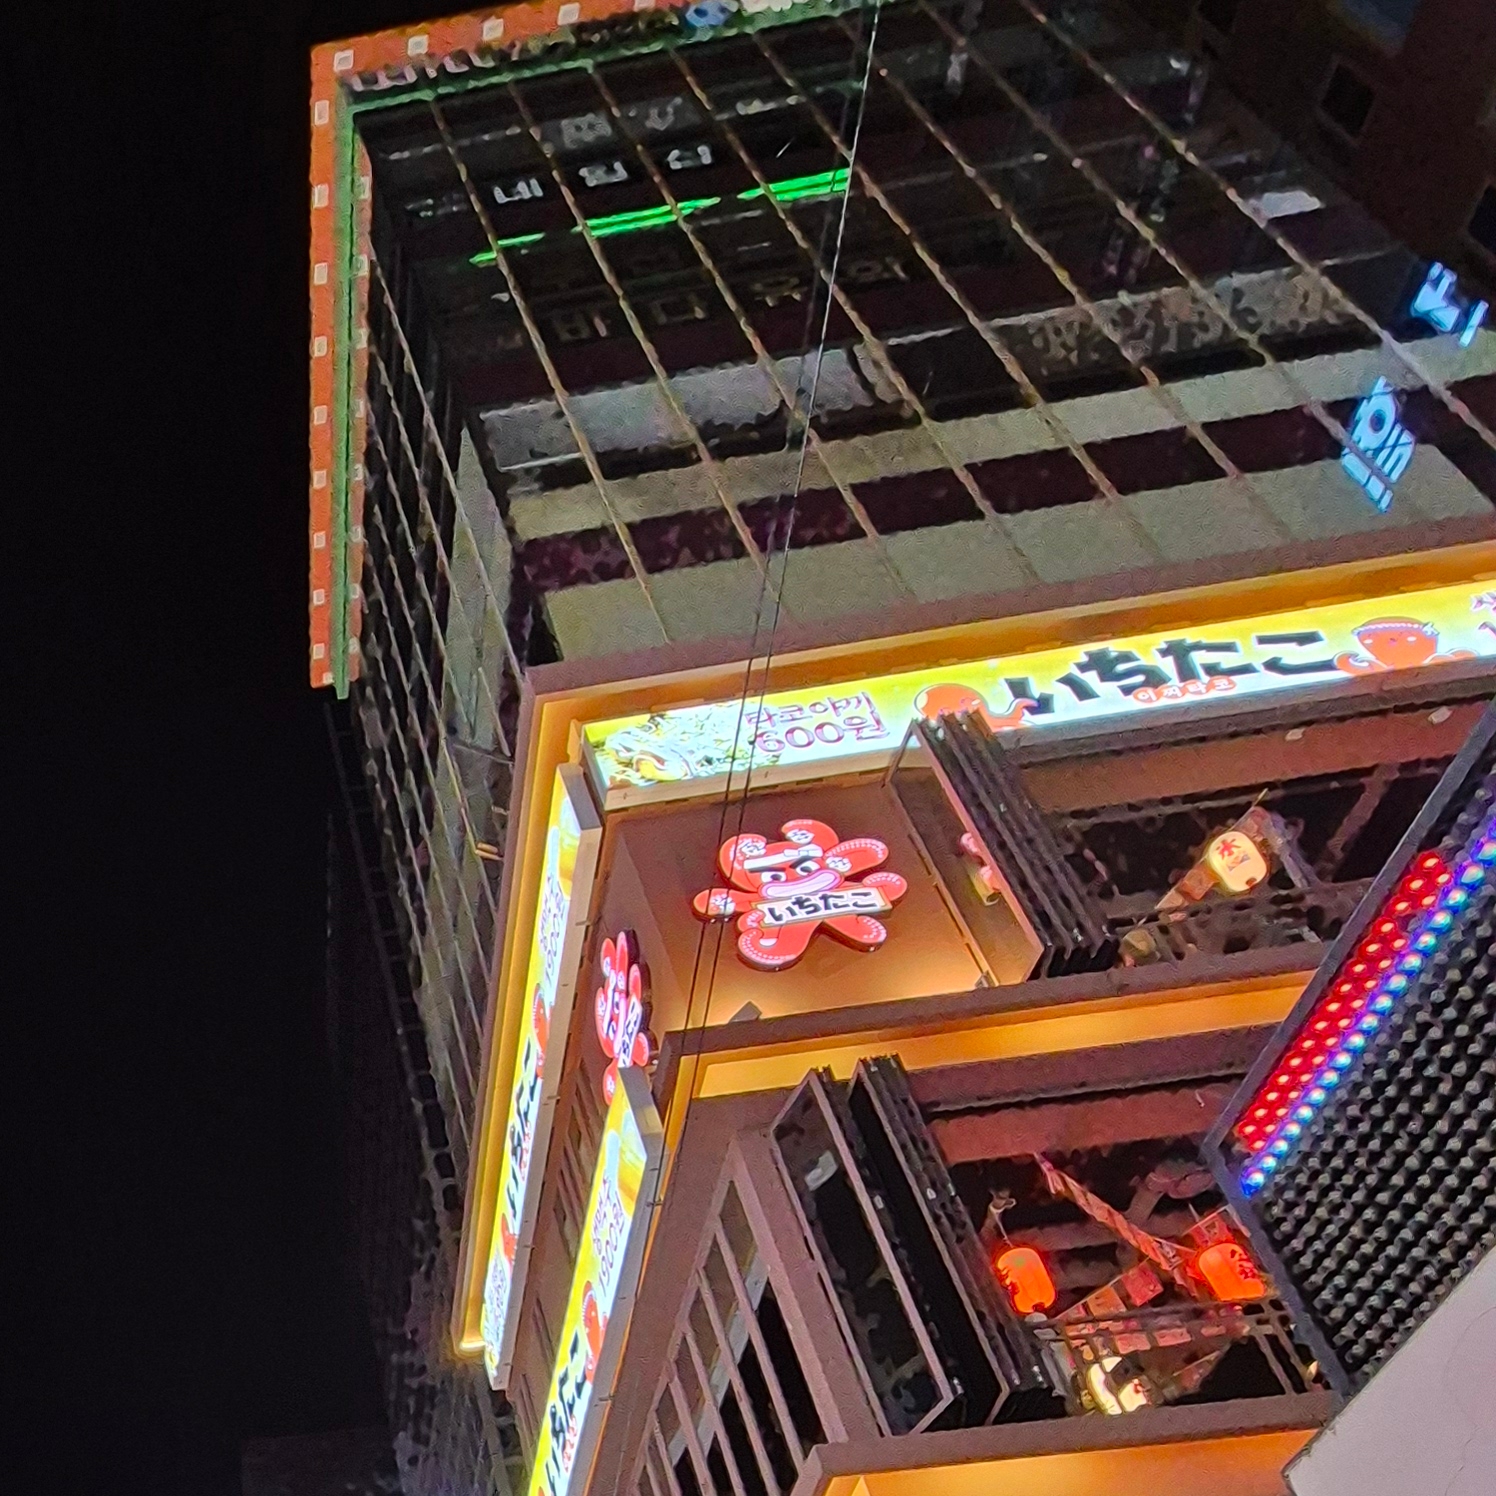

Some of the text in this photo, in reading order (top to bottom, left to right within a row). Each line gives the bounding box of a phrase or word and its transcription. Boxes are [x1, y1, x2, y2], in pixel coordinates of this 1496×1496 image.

[1006, 631, 1339, 718] いちたこ
[1134, 676, 1237, 702] 이찌타코
[754, 710, 890, 756] 600원
[767, 888, 884, 925] いちたこ
